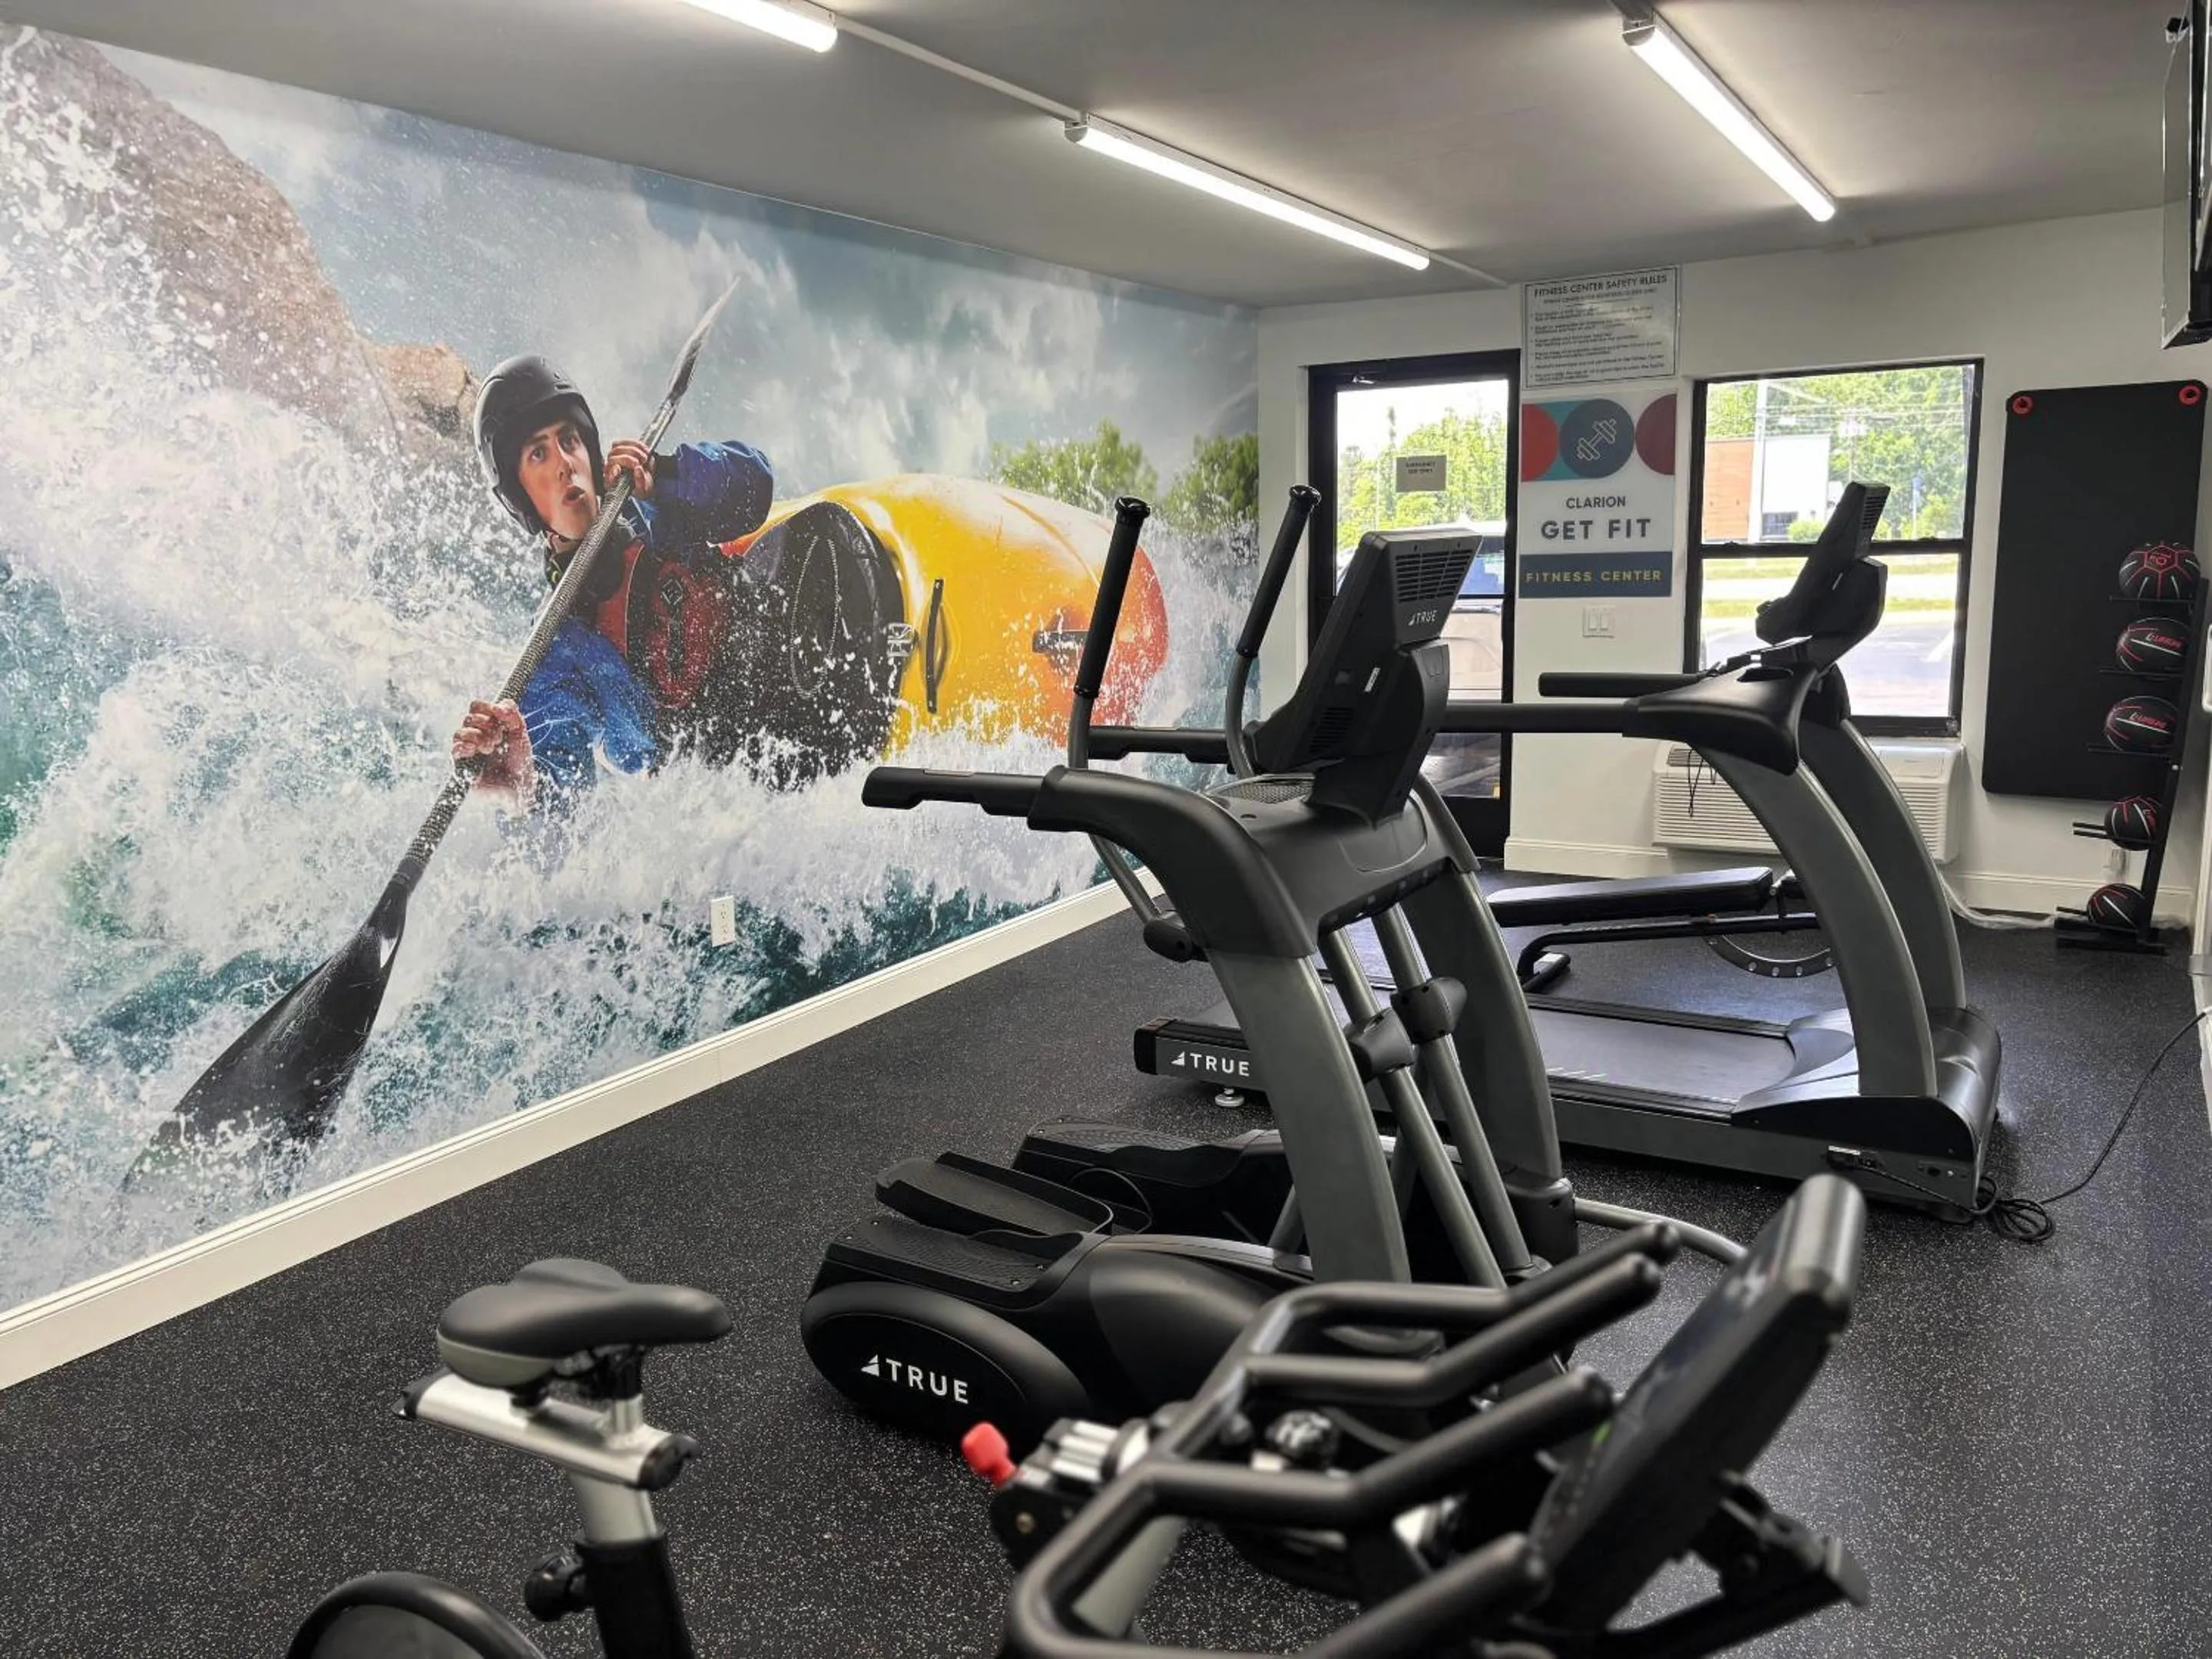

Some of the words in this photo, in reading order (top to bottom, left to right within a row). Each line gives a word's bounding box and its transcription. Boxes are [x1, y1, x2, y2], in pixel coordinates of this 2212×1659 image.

[1535, 286, 1568, 297] FITNESS
[1570, 282, 1604, 293] CENTER
[1606, 278, 1637, 290] SAFETY
[1640, 274, 1667, 286] RULES
[1565, 495, 1627, 509] CLARION
[1541, 520, 1593, 540] GET
[1608, 518, 1651, 539] FIT
[1526, 571, 1592, 582] FITNESS
[1601, 570, 1661, 581] CENTER
[1416, 610, 1437, 624] TRUE
[1190, 1052, 1250, 1076] TRUE
[886, 1358, 969, 1404] TRUE
